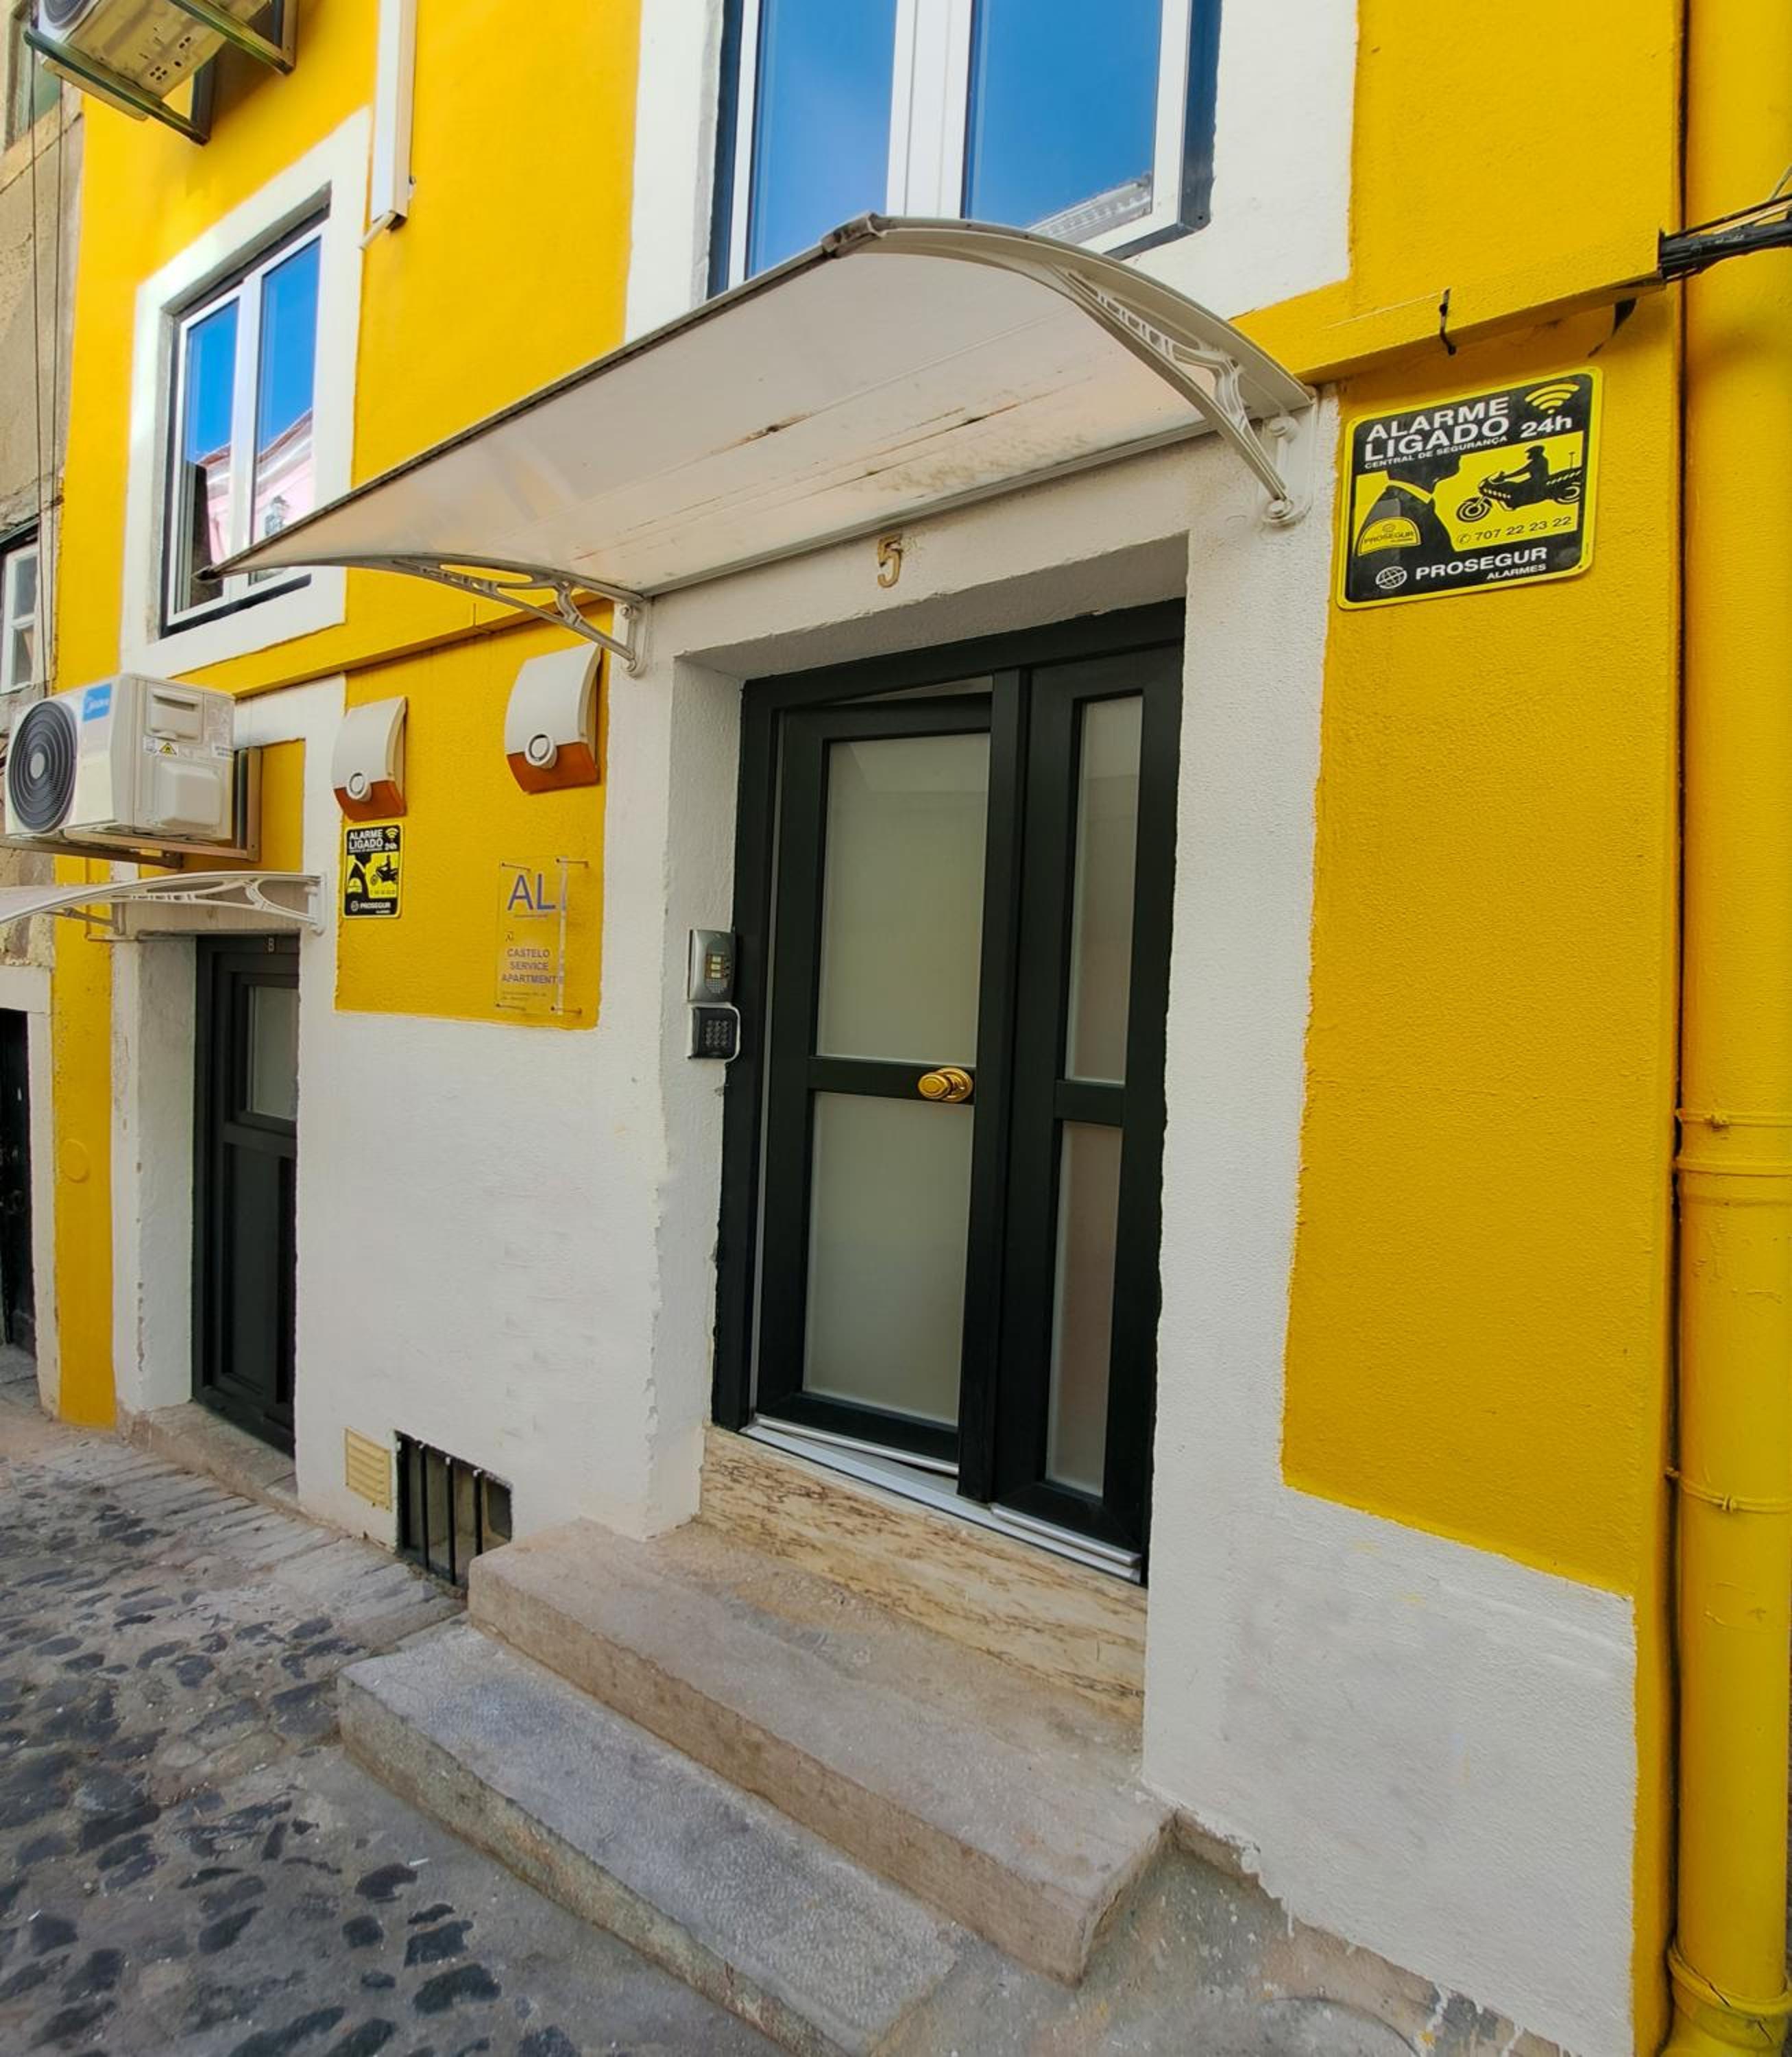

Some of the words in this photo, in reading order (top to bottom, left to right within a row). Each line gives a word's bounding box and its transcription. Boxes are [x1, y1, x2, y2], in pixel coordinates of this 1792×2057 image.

[1366, 396, 1510, 442] ALARME
[1519, 414, 1573, 439] 24h
[1365, 416, 1510, 462] LIGADO
[1364, 454, 1415, 470] CENTRAL
[1418, 450, 1434, 460] DE
[1436, 435, 1508, 455] SEGURANÇA
[1475, 529, 1502, 541] 707
[1506, 525, 1525, 536] 22
[1529, 520, 1548, 531] 23
[1553, 516, 1572, 527] 22
[877, 535, 901, 588] 5
[1416, 546, 1548, 581] PROSEGUR
[1486, 563, 1547, 580] ALARMES
[349, 829, 383, 840] ALARME
[349, 837, 383, 850] LIGADO
[507, 873, 557, 911] AL
[507, 948, 550, 958] CASTELO
[509, 961, 549, 971] SERVICE
